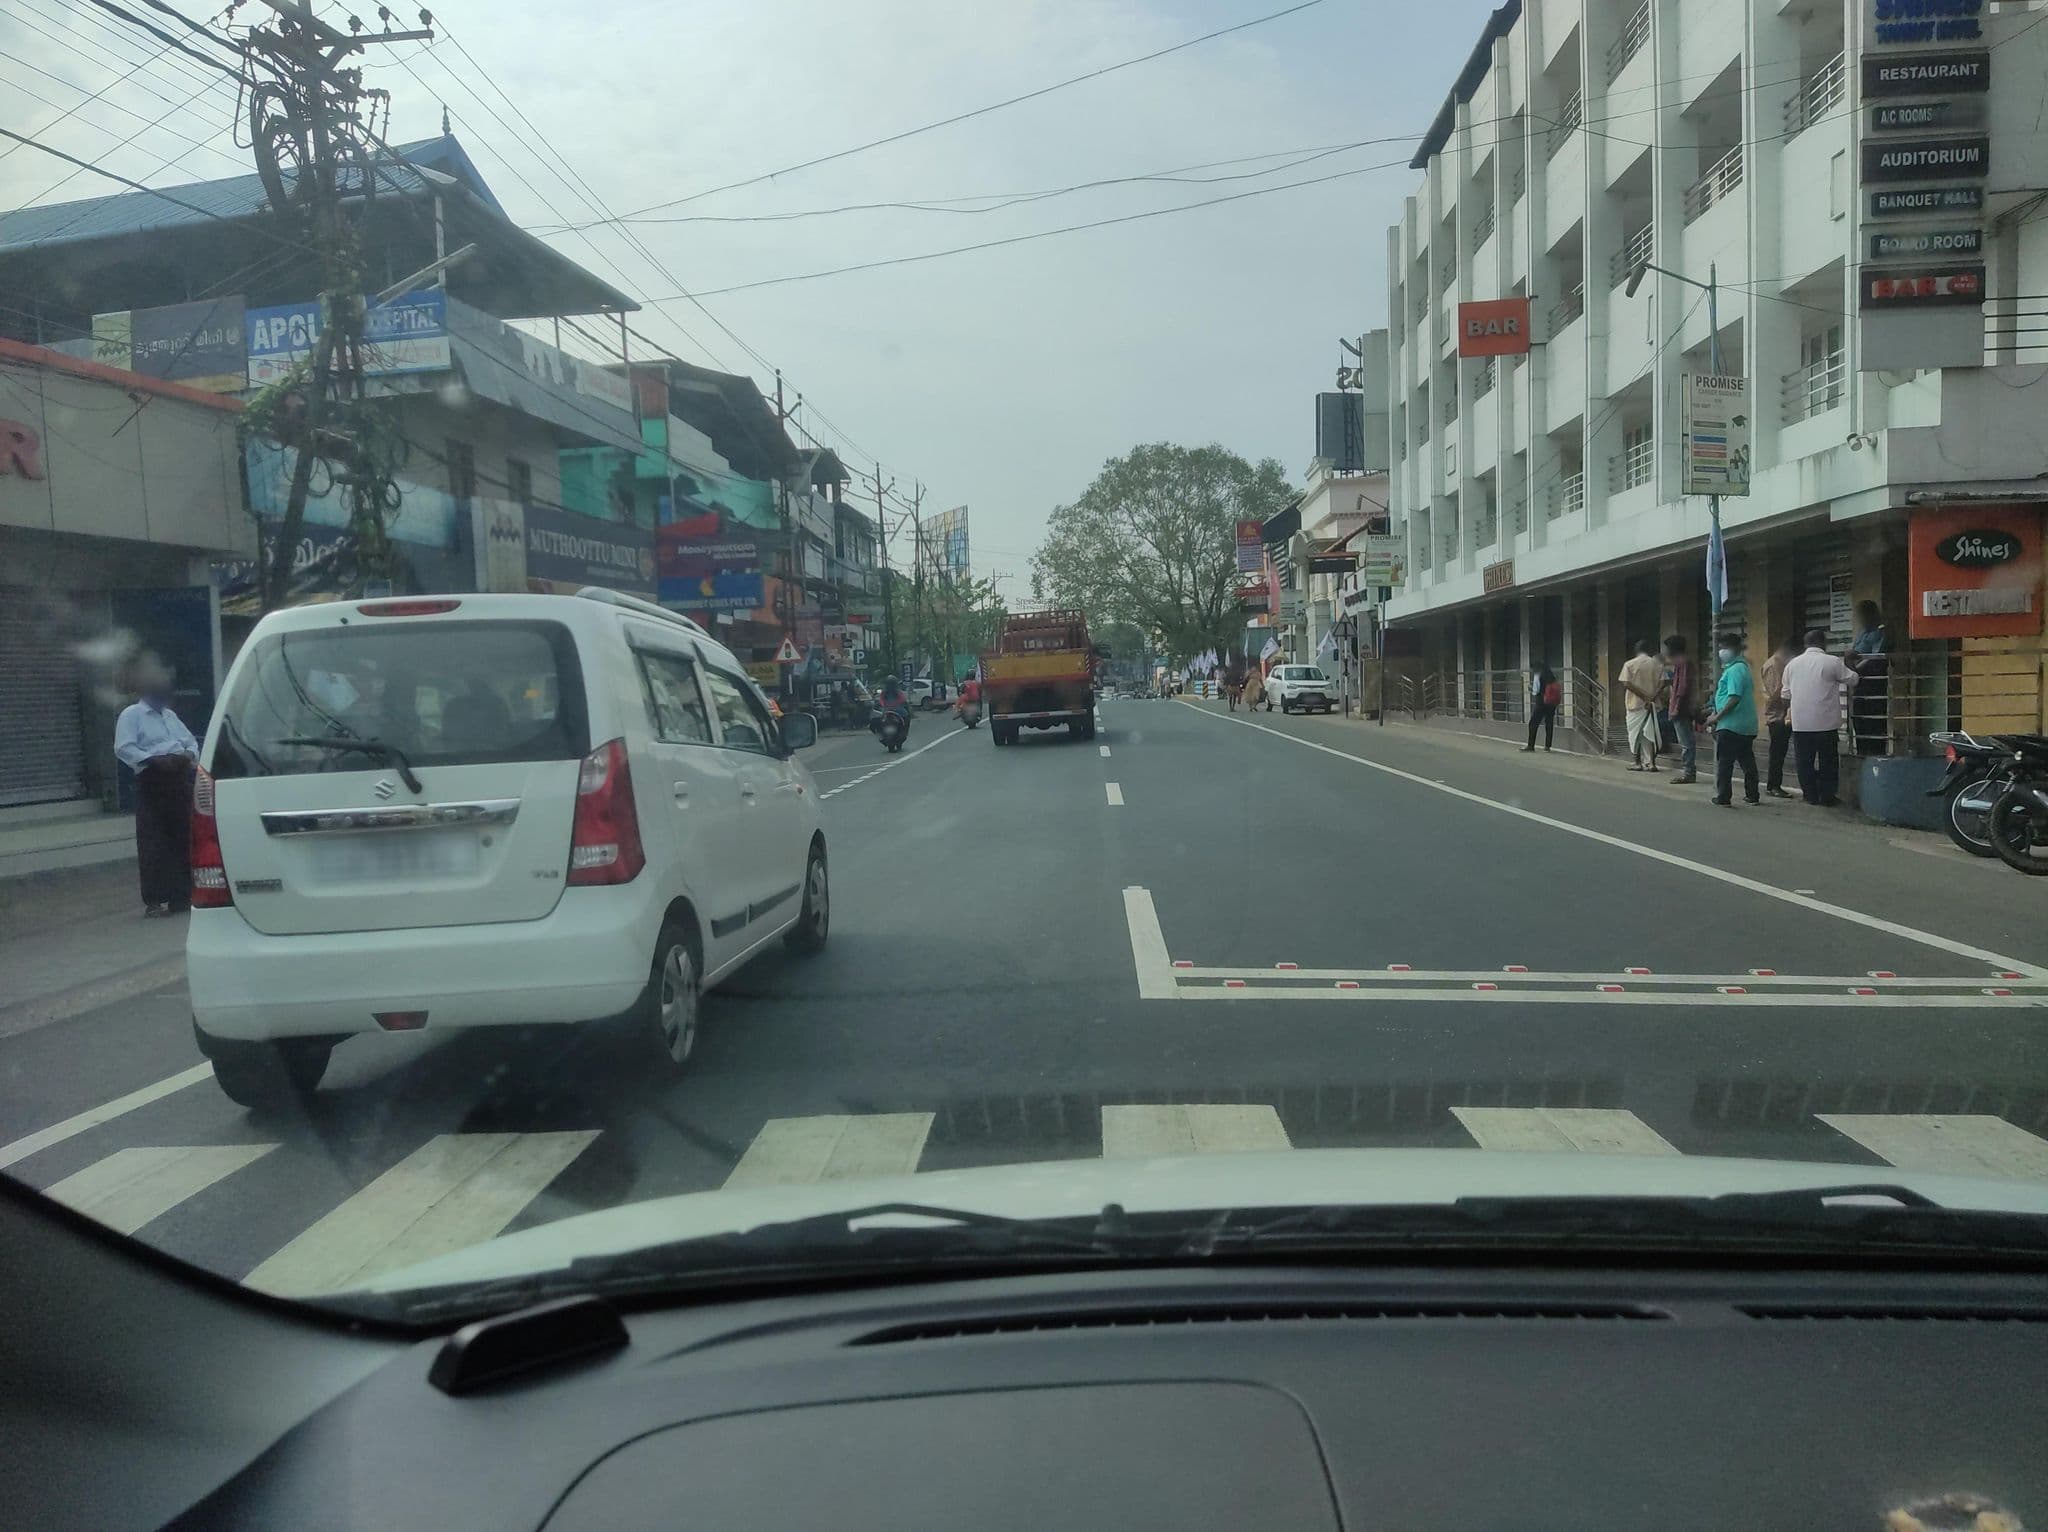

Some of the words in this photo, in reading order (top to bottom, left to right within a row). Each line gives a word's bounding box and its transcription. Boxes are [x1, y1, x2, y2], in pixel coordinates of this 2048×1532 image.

[1880, 63, 1979, 81] RESTAURANT
[1880, 110, 1896, 124] A/C
[1899, 107, 1933, 122] ROOMS
[1880, 148, 1979, 168] AUDITORIUM
[1879, 193, 1941, 208] BANQUET
[1934, 233, 1976, 249] ROOM
[1877, 276, 1937, 298] BAR
[253, 312, 322, 352] APOL
[1467, 317, 1519, 337] BAR
[1695, 375, 1744, 391] PROMISE
[529, 528, 609, 564] MUTHOOTTU
[856, 652, 865, 664] P
